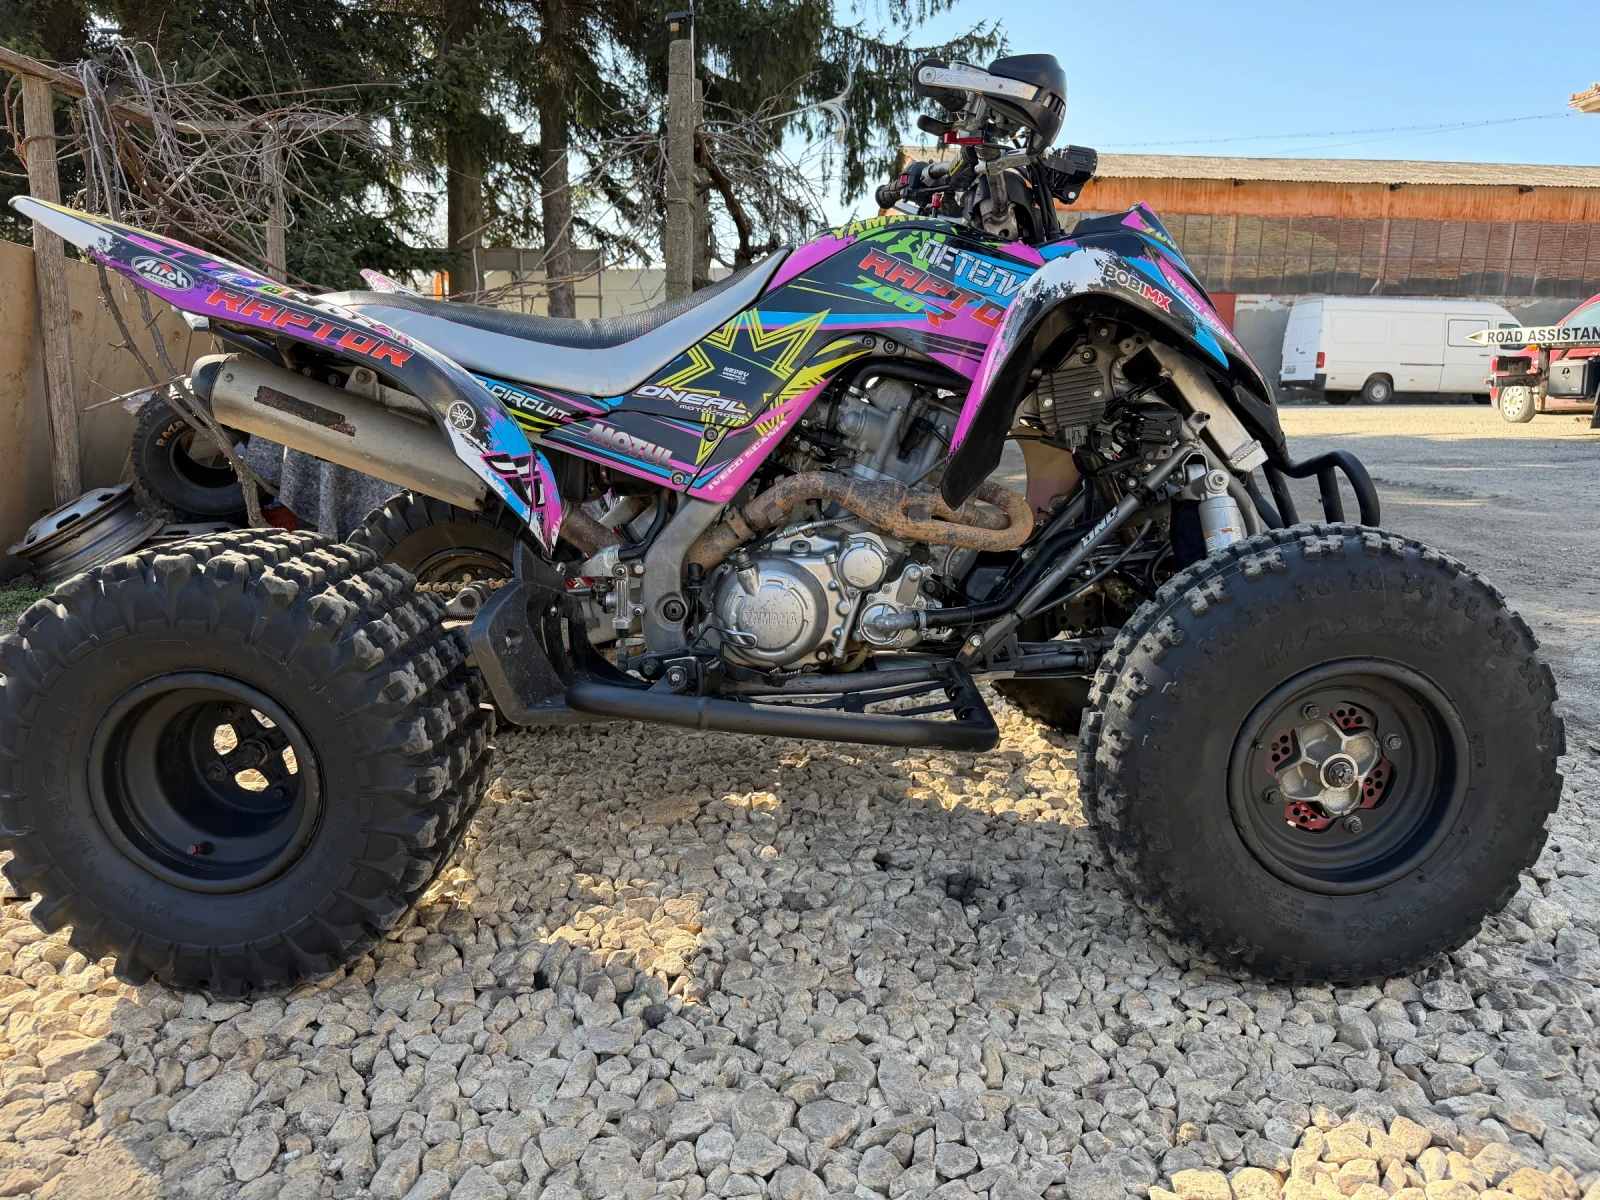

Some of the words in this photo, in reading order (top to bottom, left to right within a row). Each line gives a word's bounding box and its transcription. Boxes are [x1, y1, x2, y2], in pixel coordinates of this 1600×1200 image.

[135, 258, 189, 290] Airoh
[206, 285, 415, 368] RAPTOR
[1487, 331, 1523, 343] ROAD
[1527, 326, 1600, 342] ASSISTAN
[491, 384, 571, 420] CIRCUIT
[679, 404, 747, 421] MOTOCROSS
[585, 422, 673, 469] MOTUL
[707, 458, 744, 491] IVECO
[744, 419, 788, 458] SCANIA
[743, 611, 798, 626] YAMAHA
